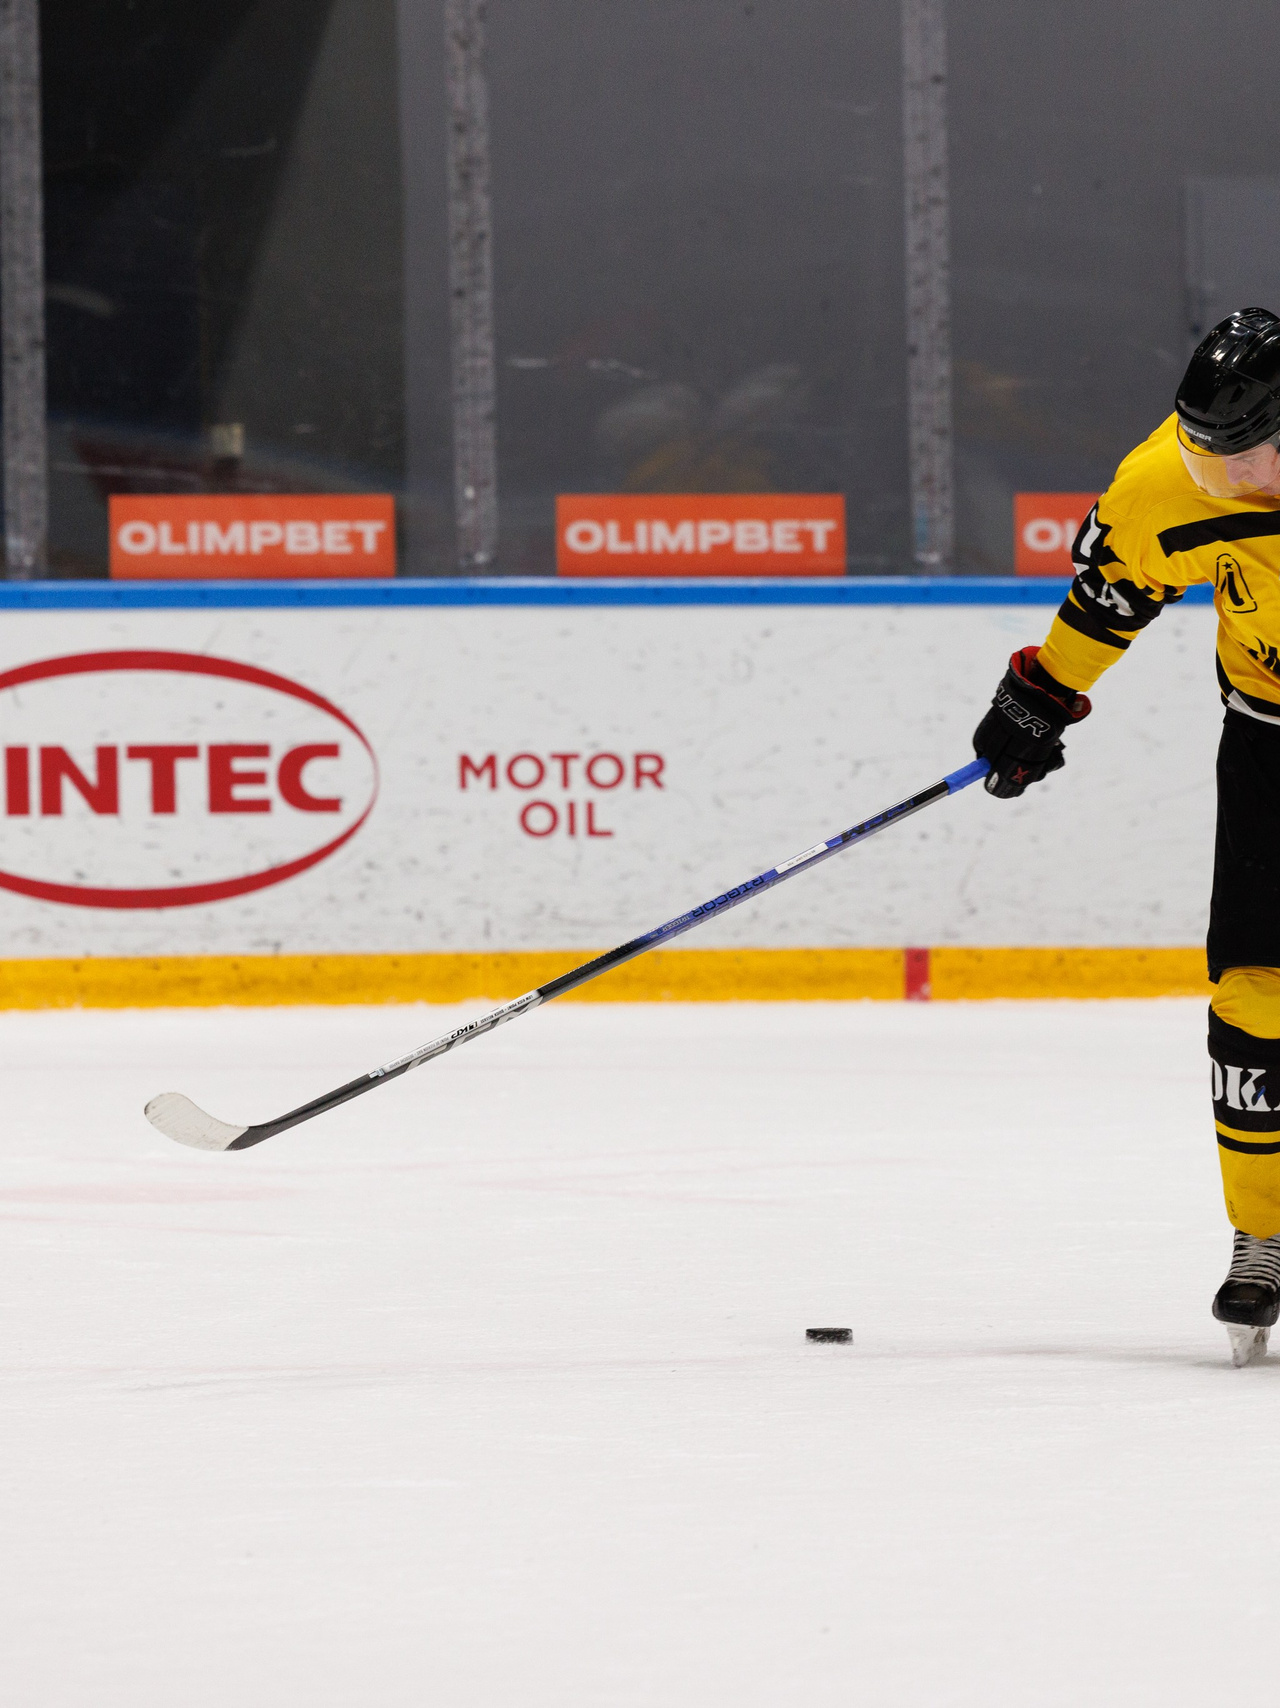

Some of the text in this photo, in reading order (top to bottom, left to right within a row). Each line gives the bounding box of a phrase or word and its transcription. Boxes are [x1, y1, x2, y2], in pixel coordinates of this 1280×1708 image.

[1183, 424, 1212, 441] BAUER
[117, 520, 386, 555] OLIMPBET
[565, 520, 836, 554] OLIMPBET
[5, 744, 342, 817] INTEC
[458, 753, 666, 790] MOTOR
[520, 801, 614, 838] OIL
